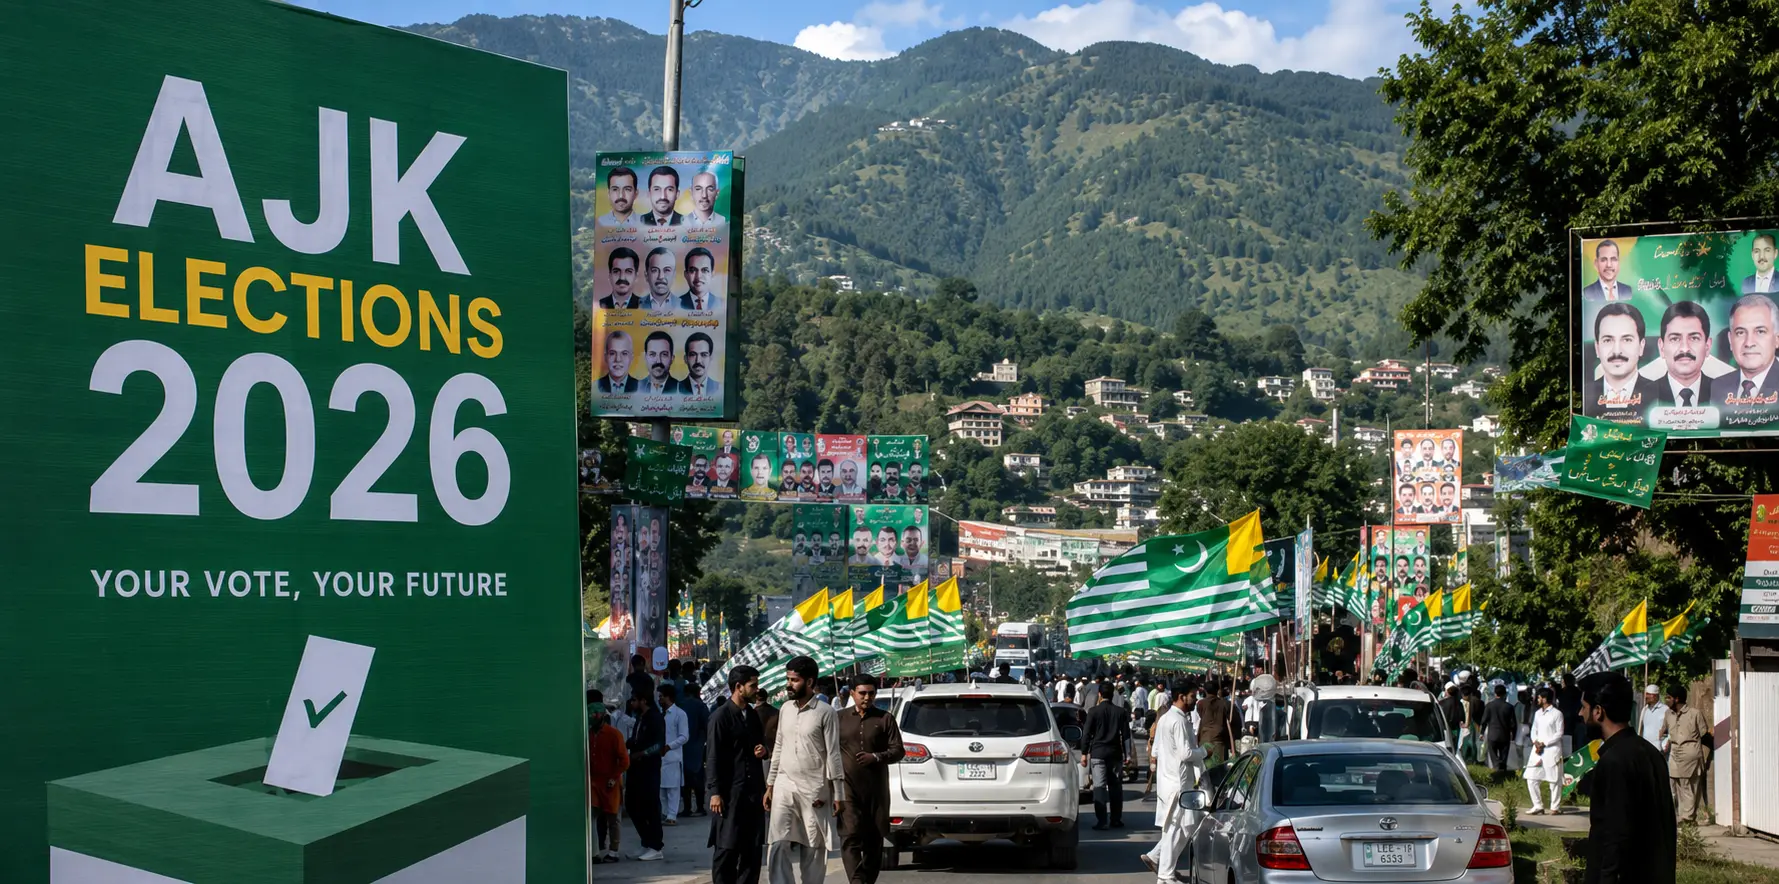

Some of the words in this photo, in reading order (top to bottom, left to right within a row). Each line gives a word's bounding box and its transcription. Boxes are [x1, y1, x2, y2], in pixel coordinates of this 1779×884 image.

[113, 75, 471, 275] AJK
[85, 244, 503, 359] ELECTIONS
[90, 340, 511, 526] 2026
[91, 569, 190, 598] YOUR
[204, 570, 300, 601] VOTE,
[313, 571, 395, 597] YOUR
[407, 572, 507, 597] FUTURE
